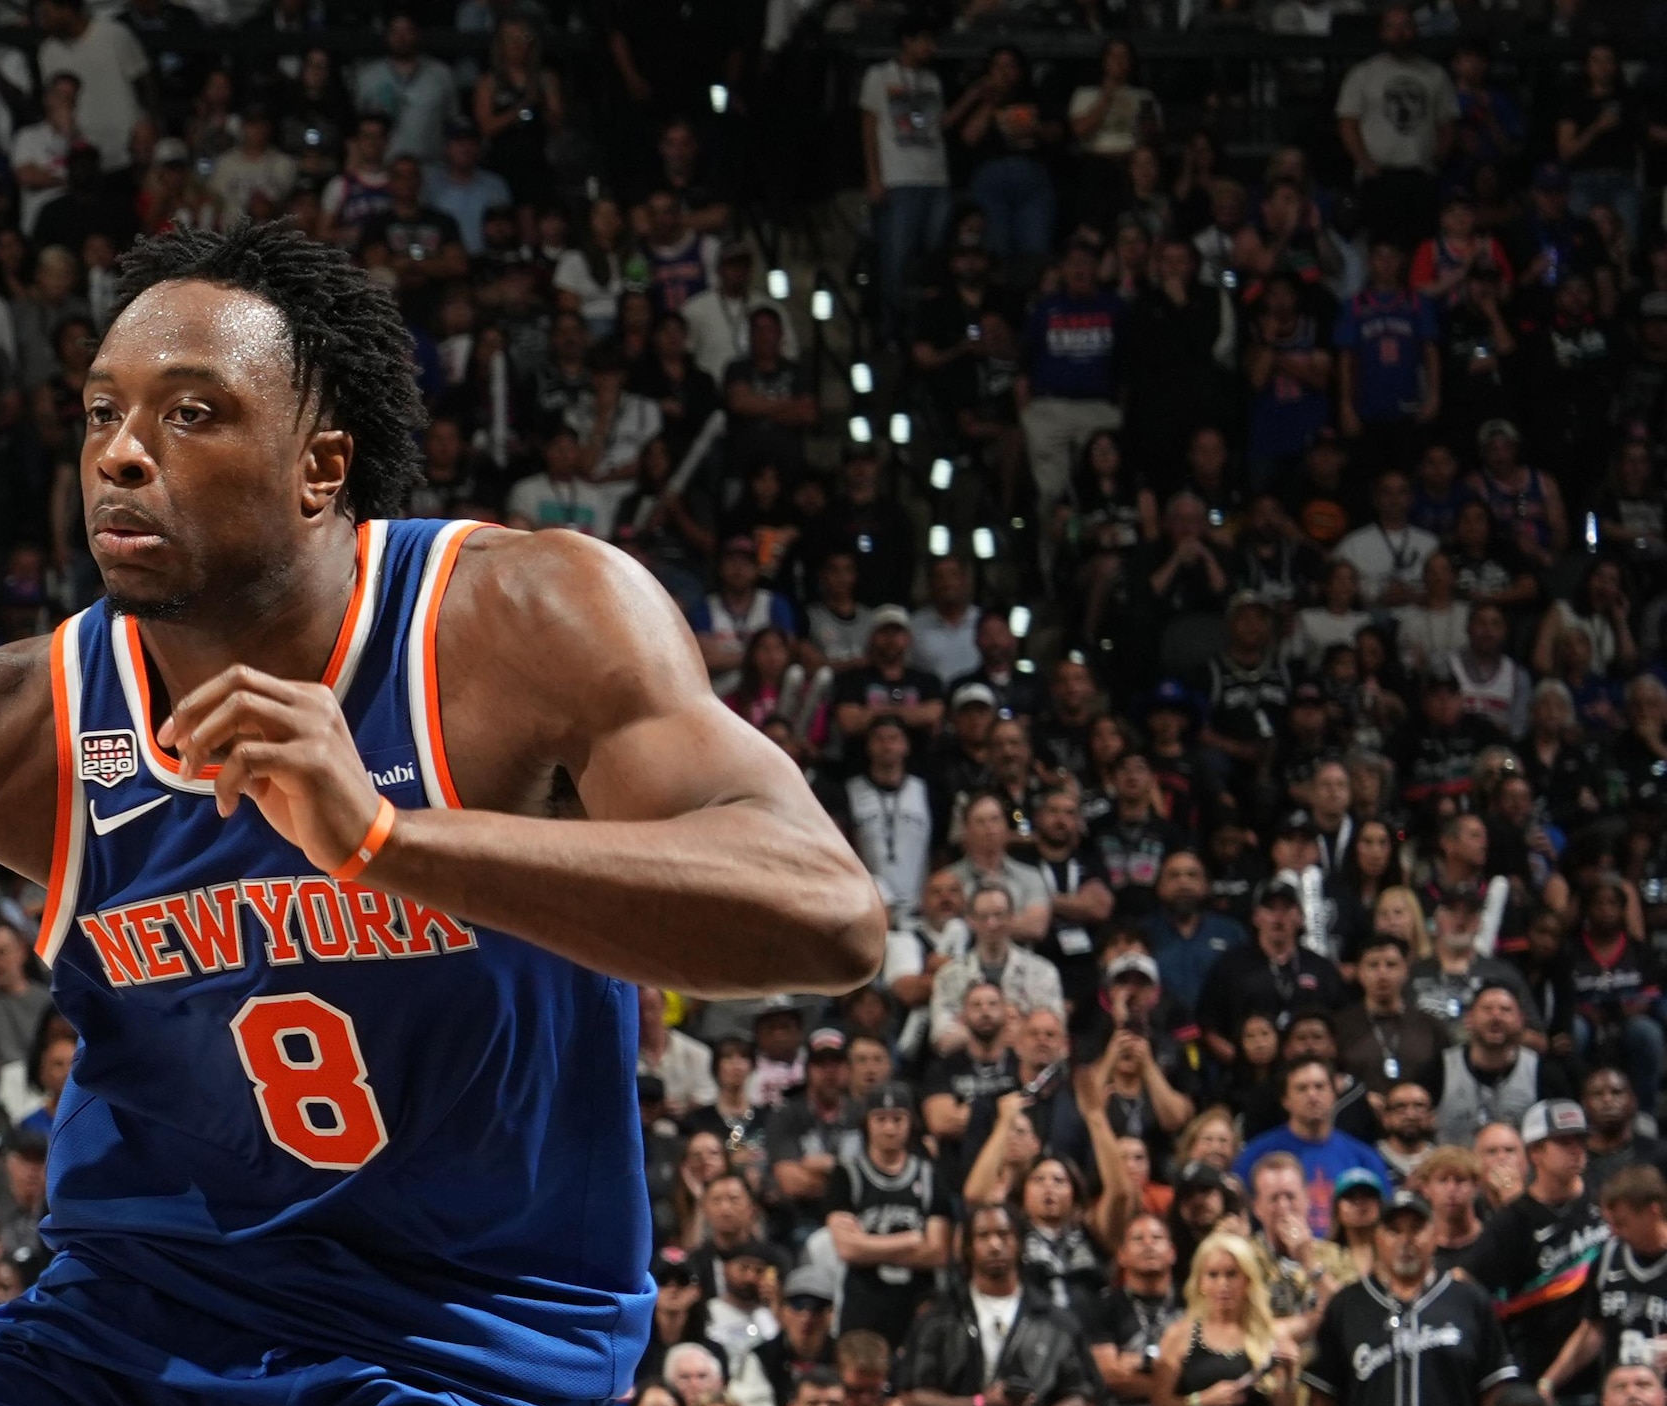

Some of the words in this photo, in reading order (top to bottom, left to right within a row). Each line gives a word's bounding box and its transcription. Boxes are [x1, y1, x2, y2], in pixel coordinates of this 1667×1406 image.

[83, 757, 133, 775] 250
[84, 737, 129, 751] USA
[76, 880, 245, 988] NEW
[239, 875, 479, 966] YORK
[229, 992, 389, 1171] 8
